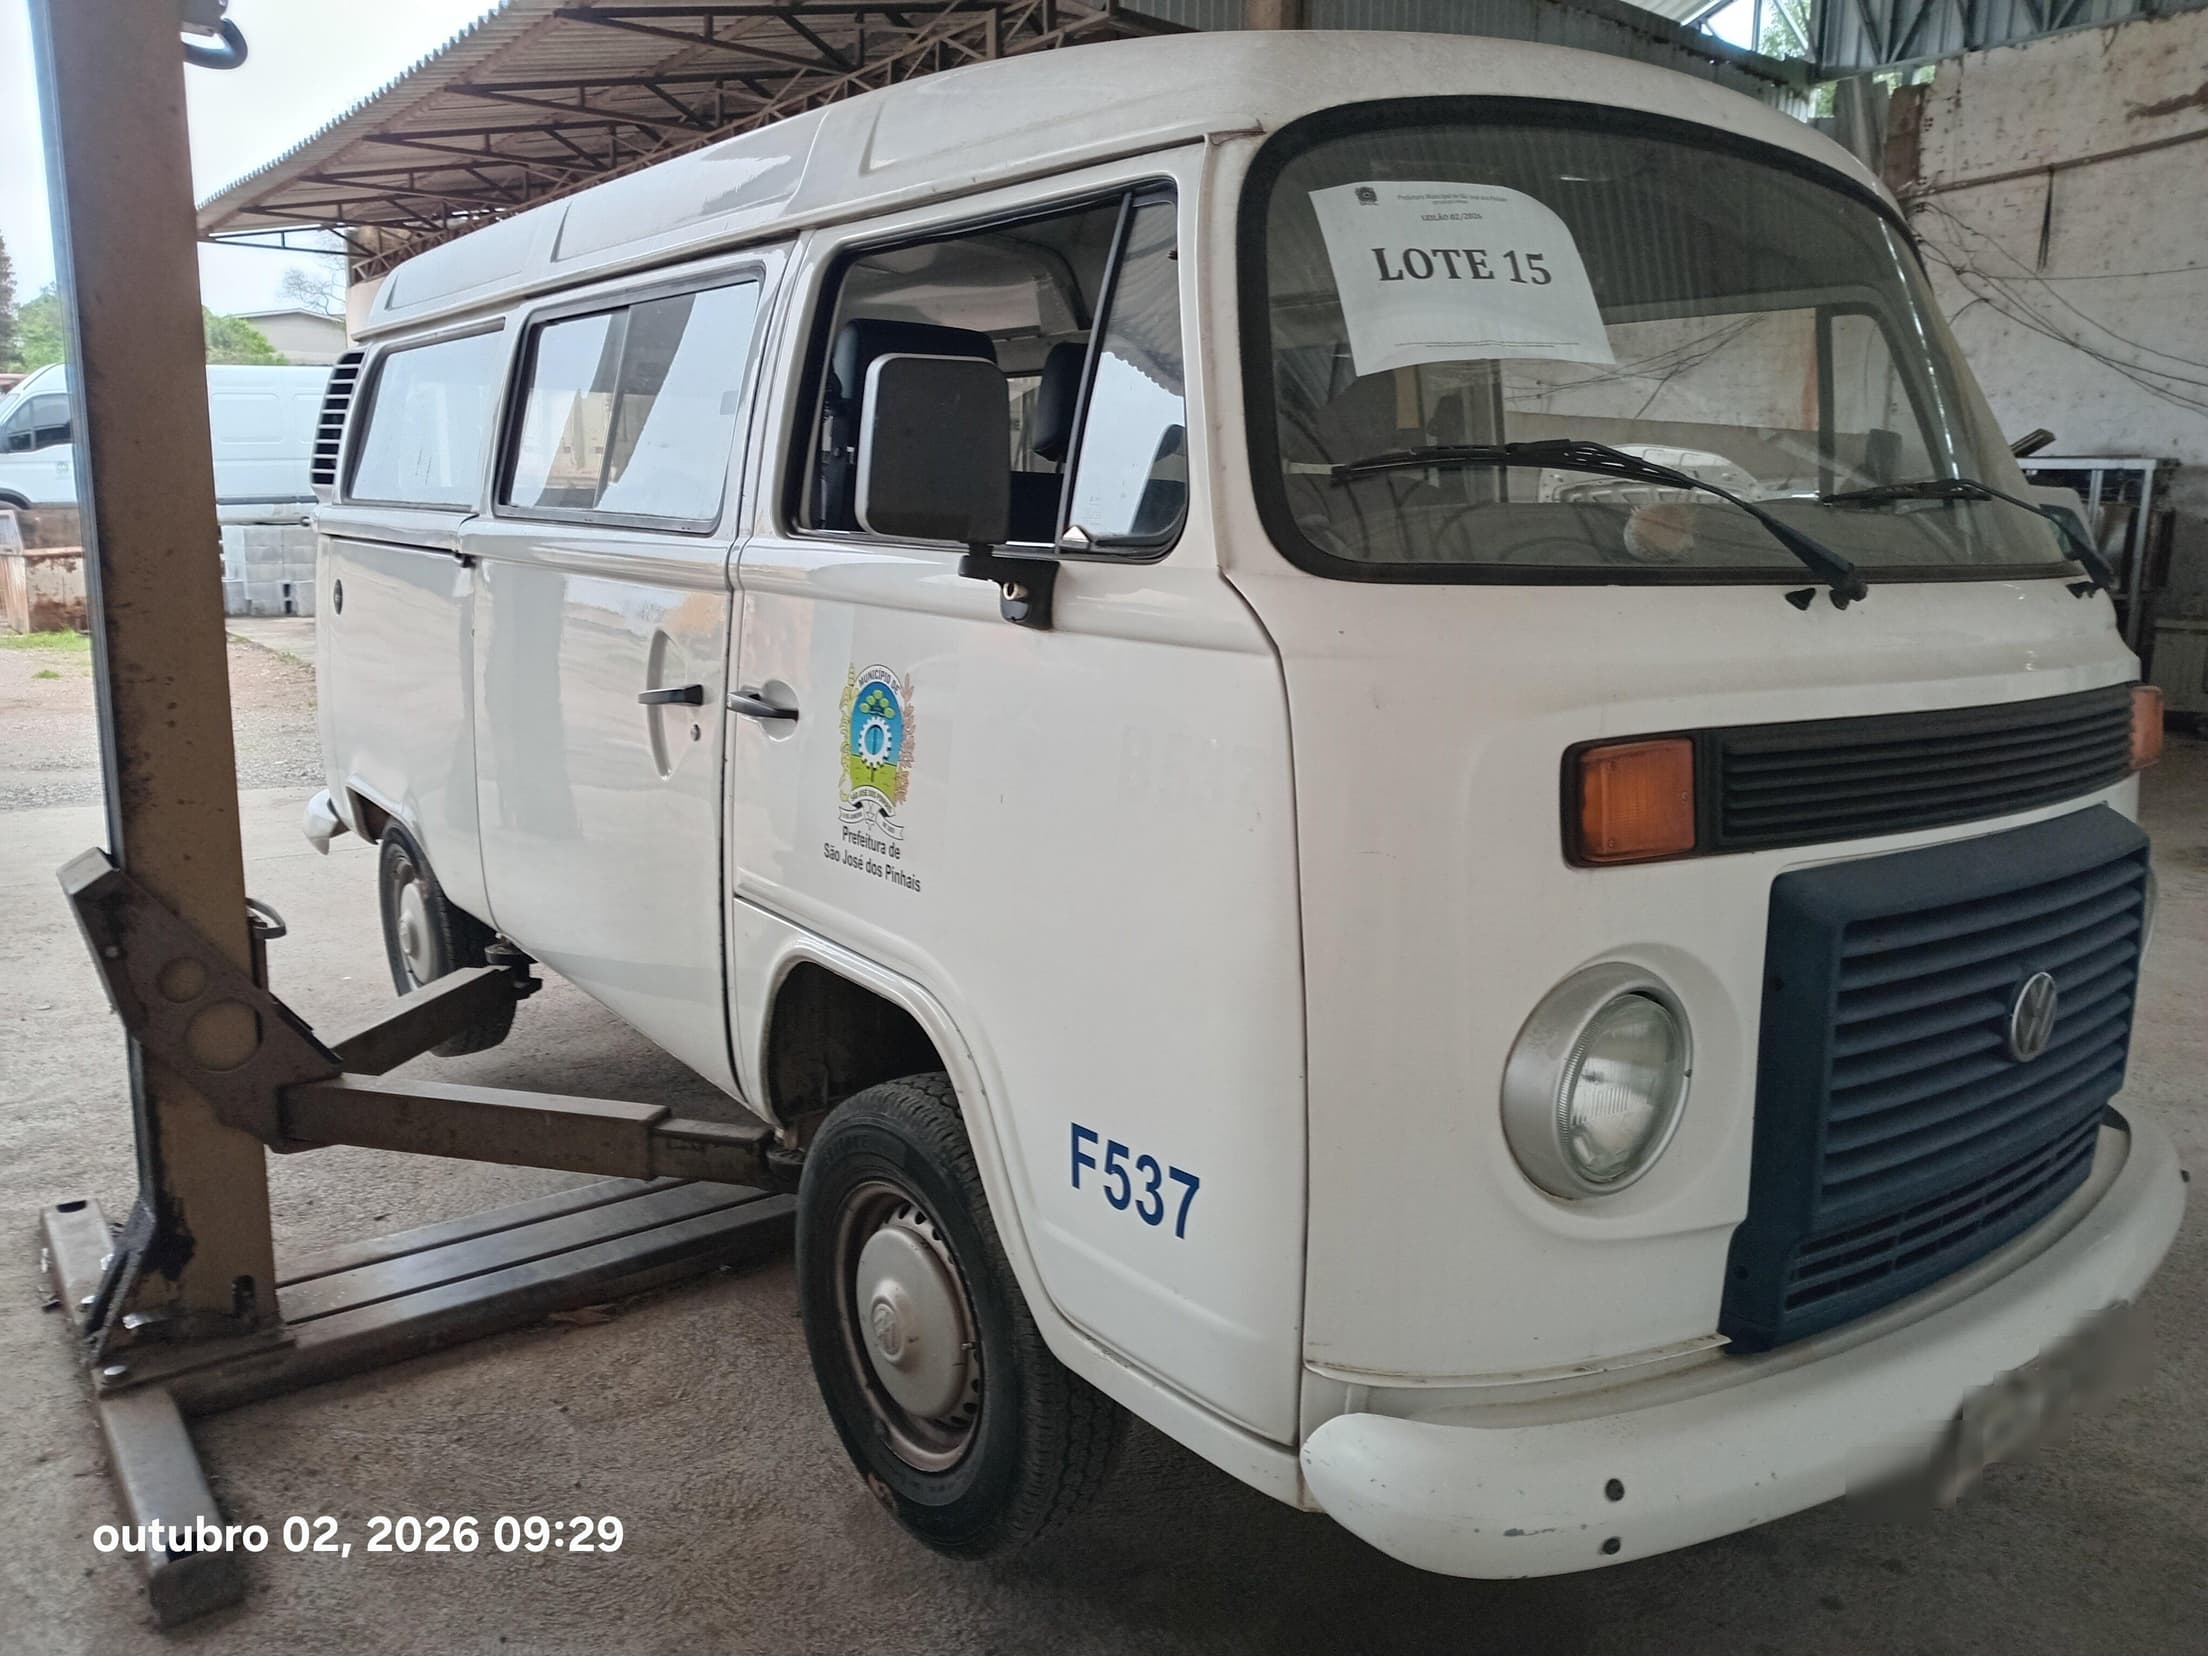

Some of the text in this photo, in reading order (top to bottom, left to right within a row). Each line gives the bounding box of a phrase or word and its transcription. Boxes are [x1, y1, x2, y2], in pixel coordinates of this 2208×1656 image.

[1371, 247, 1552, 286] LOTE 15
[842, 825, 886, 856] Prefeitura
[888, 841, 900, 860] de
[823, 842, 921, 893] São José dos Pinhais
[1071, 1121, 1201, 1240] F537
